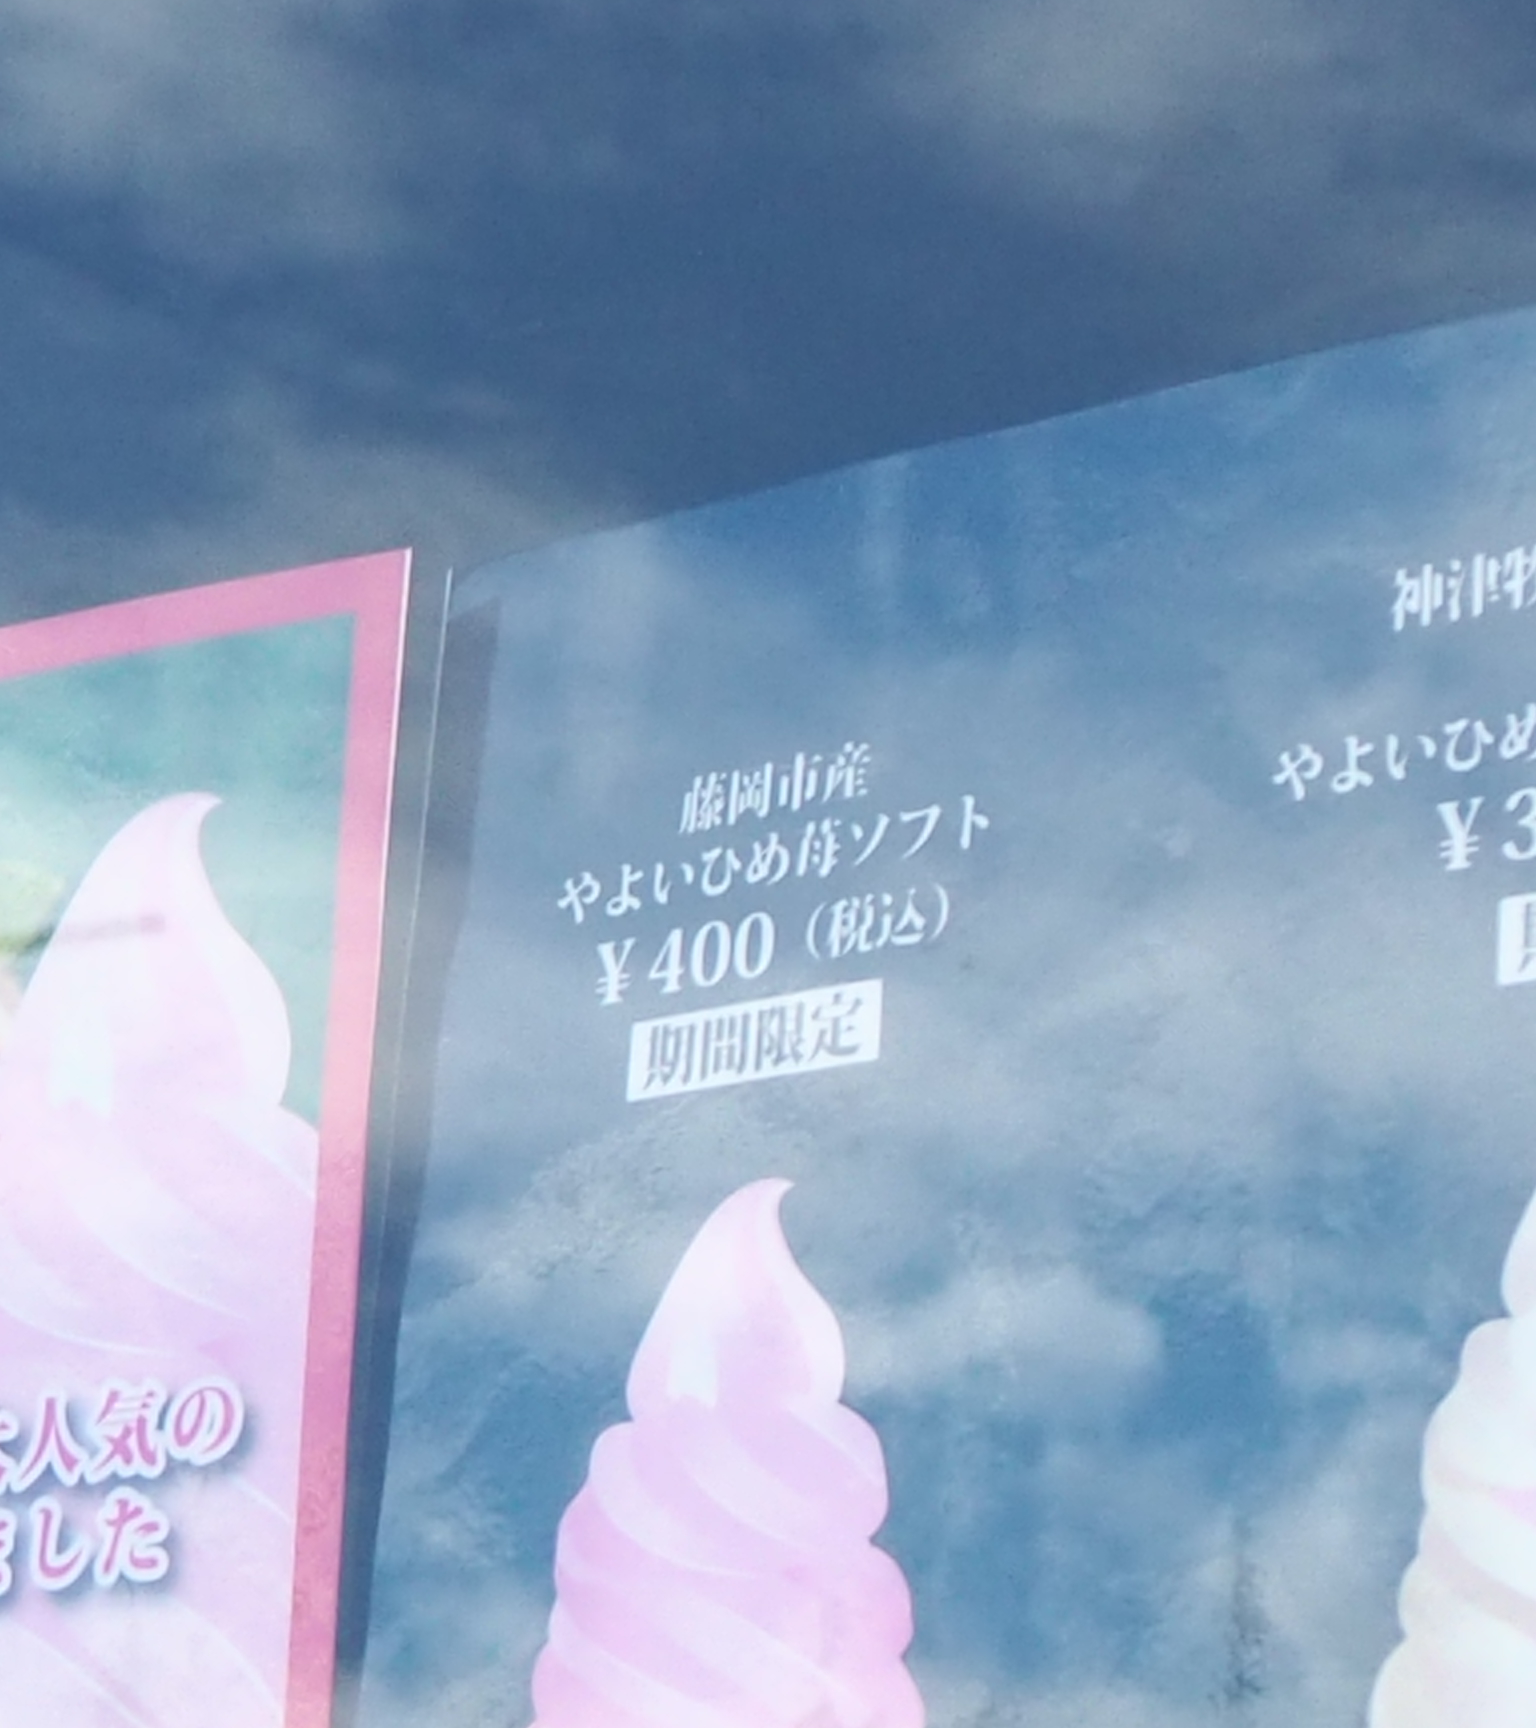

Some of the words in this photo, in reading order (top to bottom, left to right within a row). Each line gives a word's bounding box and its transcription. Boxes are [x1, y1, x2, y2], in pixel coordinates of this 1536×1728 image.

[680, 741, 871, 835] 藤岡市産
[558, 795, 989, 924] やよいひめ苺ソフト
[642, 991, 865, 1090] 期間限定
